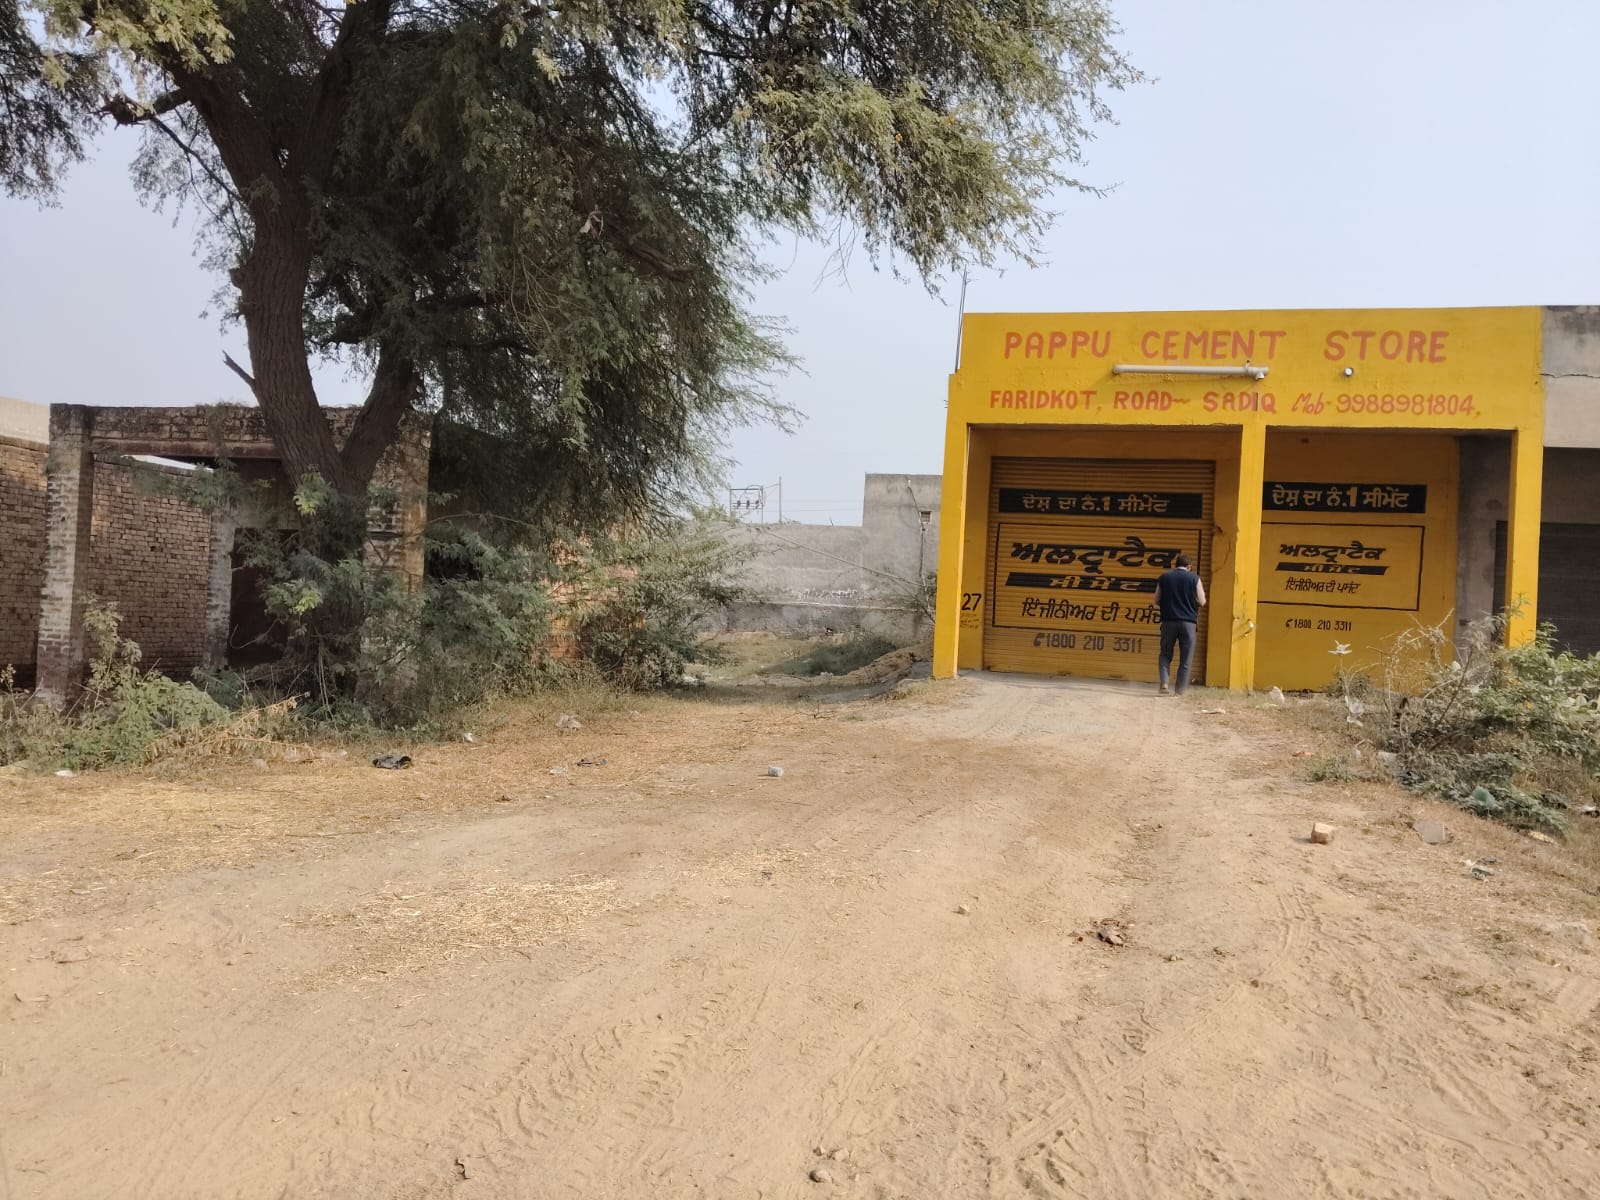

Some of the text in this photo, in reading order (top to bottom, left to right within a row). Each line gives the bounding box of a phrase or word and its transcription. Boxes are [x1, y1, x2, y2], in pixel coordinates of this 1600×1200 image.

[1004, 329, 1450, 364] PAPPU CEMENT STORE
[1202, 391, 1277, 415] SADIQ
[1058, 496, 1077, 511] ਦਾ
[1303, 489, 1322, 506] ਦਾ
[1325, 579, 1336, 593] ਦੀ
[961, 593, 982, 611] 27
[1100, 601, 1120, 622] ਦੀ
[1294, 618, 1352, 631] 1800 210 3311
[1046, 632, 1142, 653] 1800 210 3311
